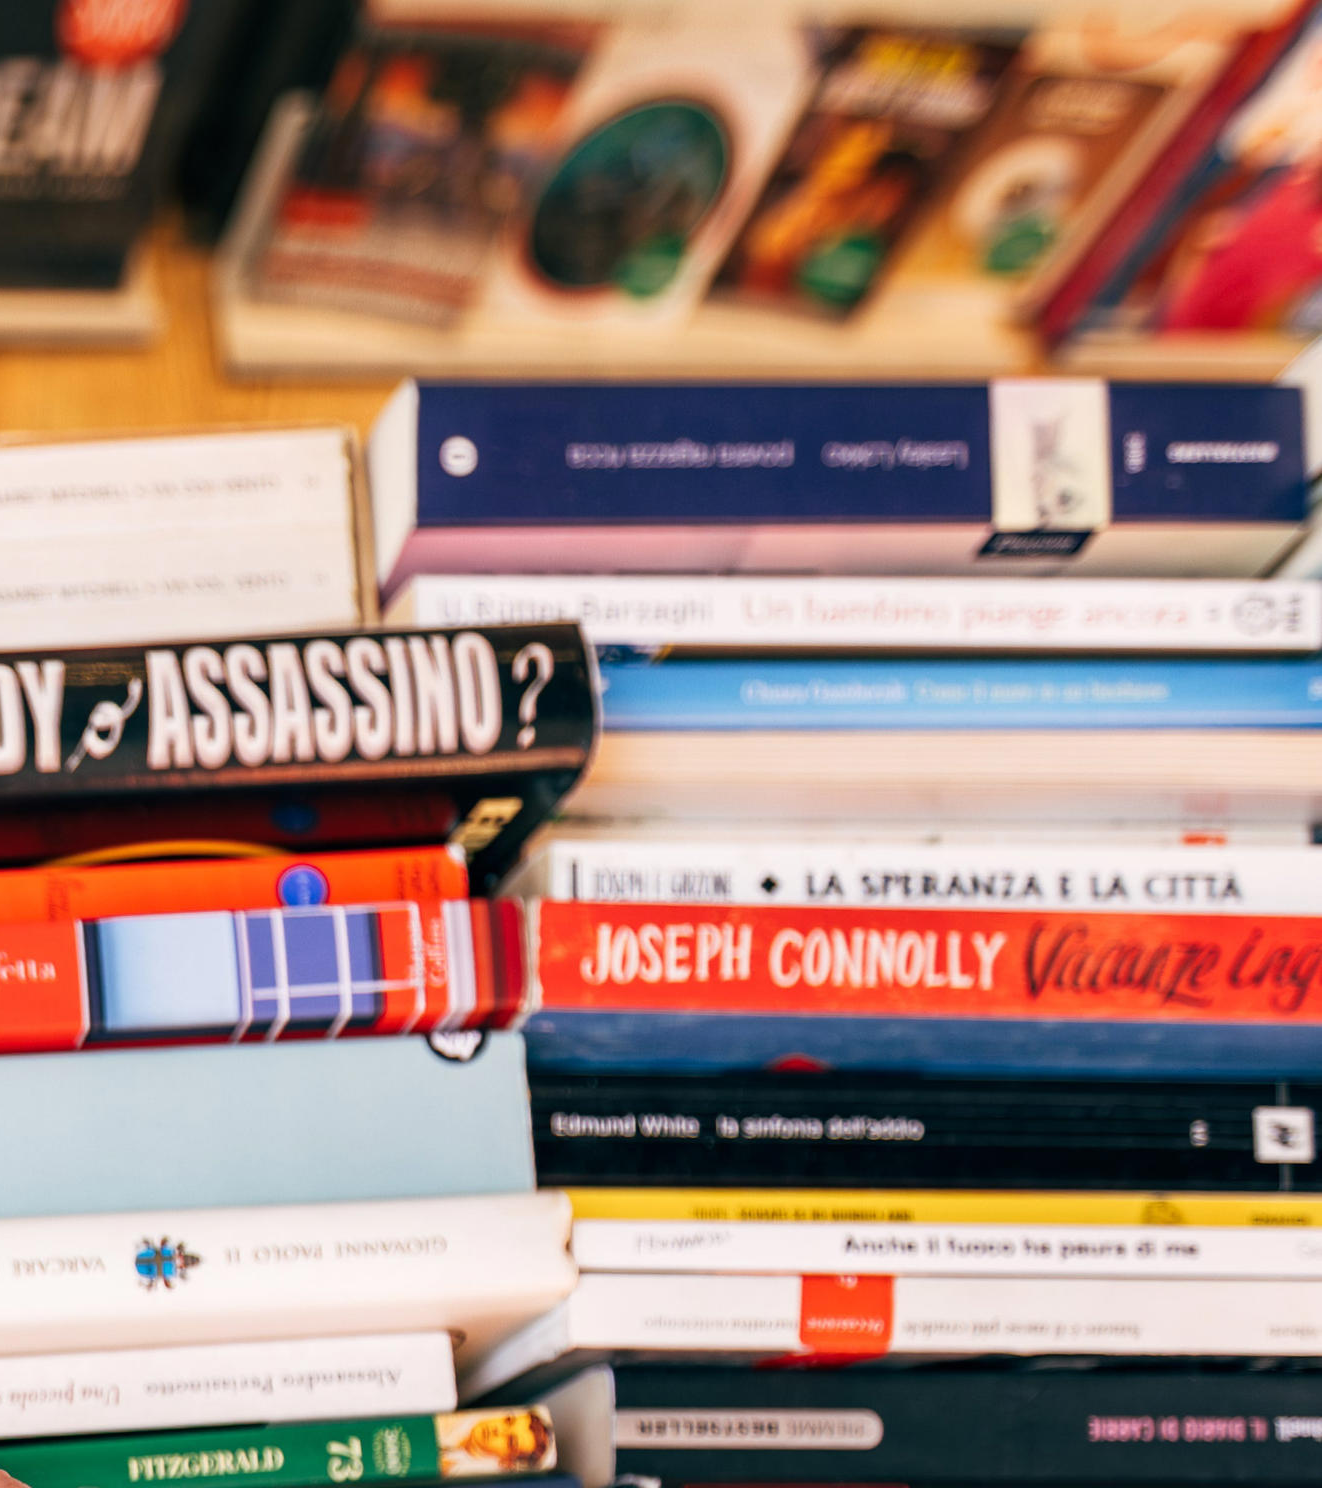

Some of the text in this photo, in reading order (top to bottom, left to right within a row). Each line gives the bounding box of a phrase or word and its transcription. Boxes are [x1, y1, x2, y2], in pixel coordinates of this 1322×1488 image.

[144, 628, 501, 770] ASSASSINO
[805, 871, 847, 899] LA
[859, 869, 1041, 902] SPERANZA
[1089, 873, 1131, 901] LA
[579, 922, 755, 986] JOSEPH
[767, 926, 1007, 991] CONNOLLY
[127, 1439, 365, 1484] FITZGERALD 73
